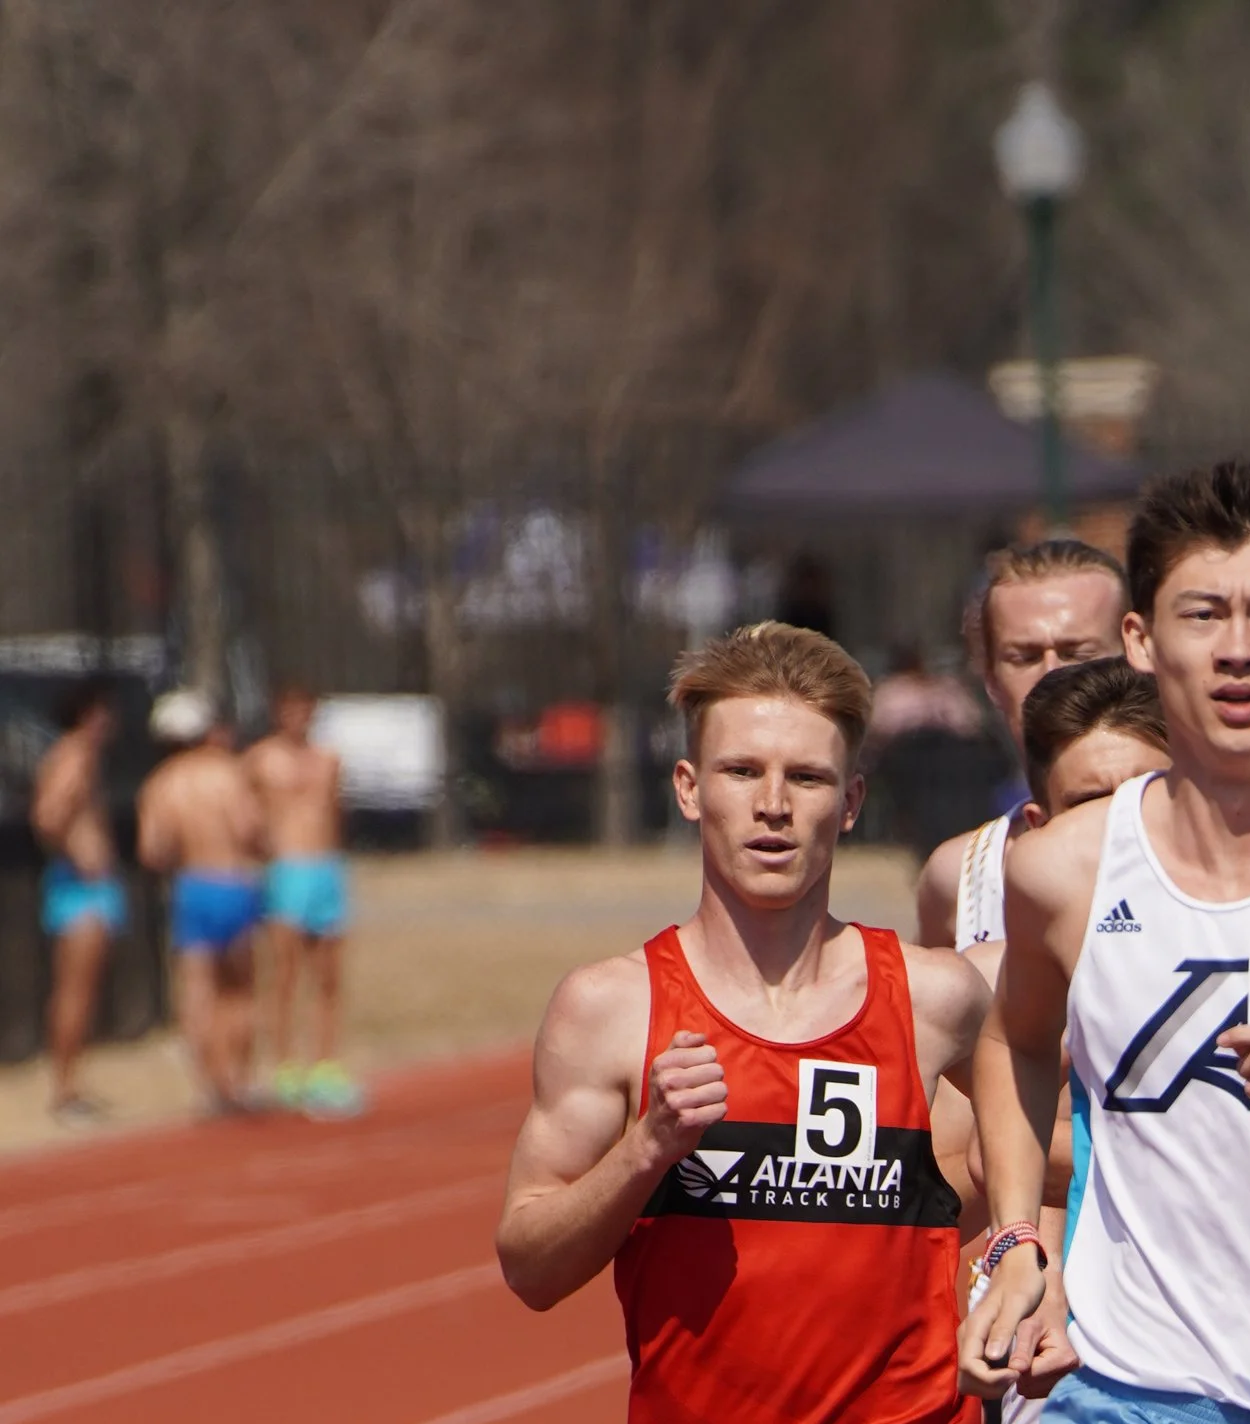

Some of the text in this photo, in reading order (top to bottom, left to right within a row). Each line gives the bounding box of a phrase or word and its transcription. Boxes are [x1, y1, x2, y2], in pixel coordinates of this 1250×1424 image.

[1096, 919, 1142, 933] adidas
[806, 1068, 863, 1158] 5
[750, 1155, 903, 1192] ATLANTA
[750, 1189, 901, 1209] TRACK CLUB
